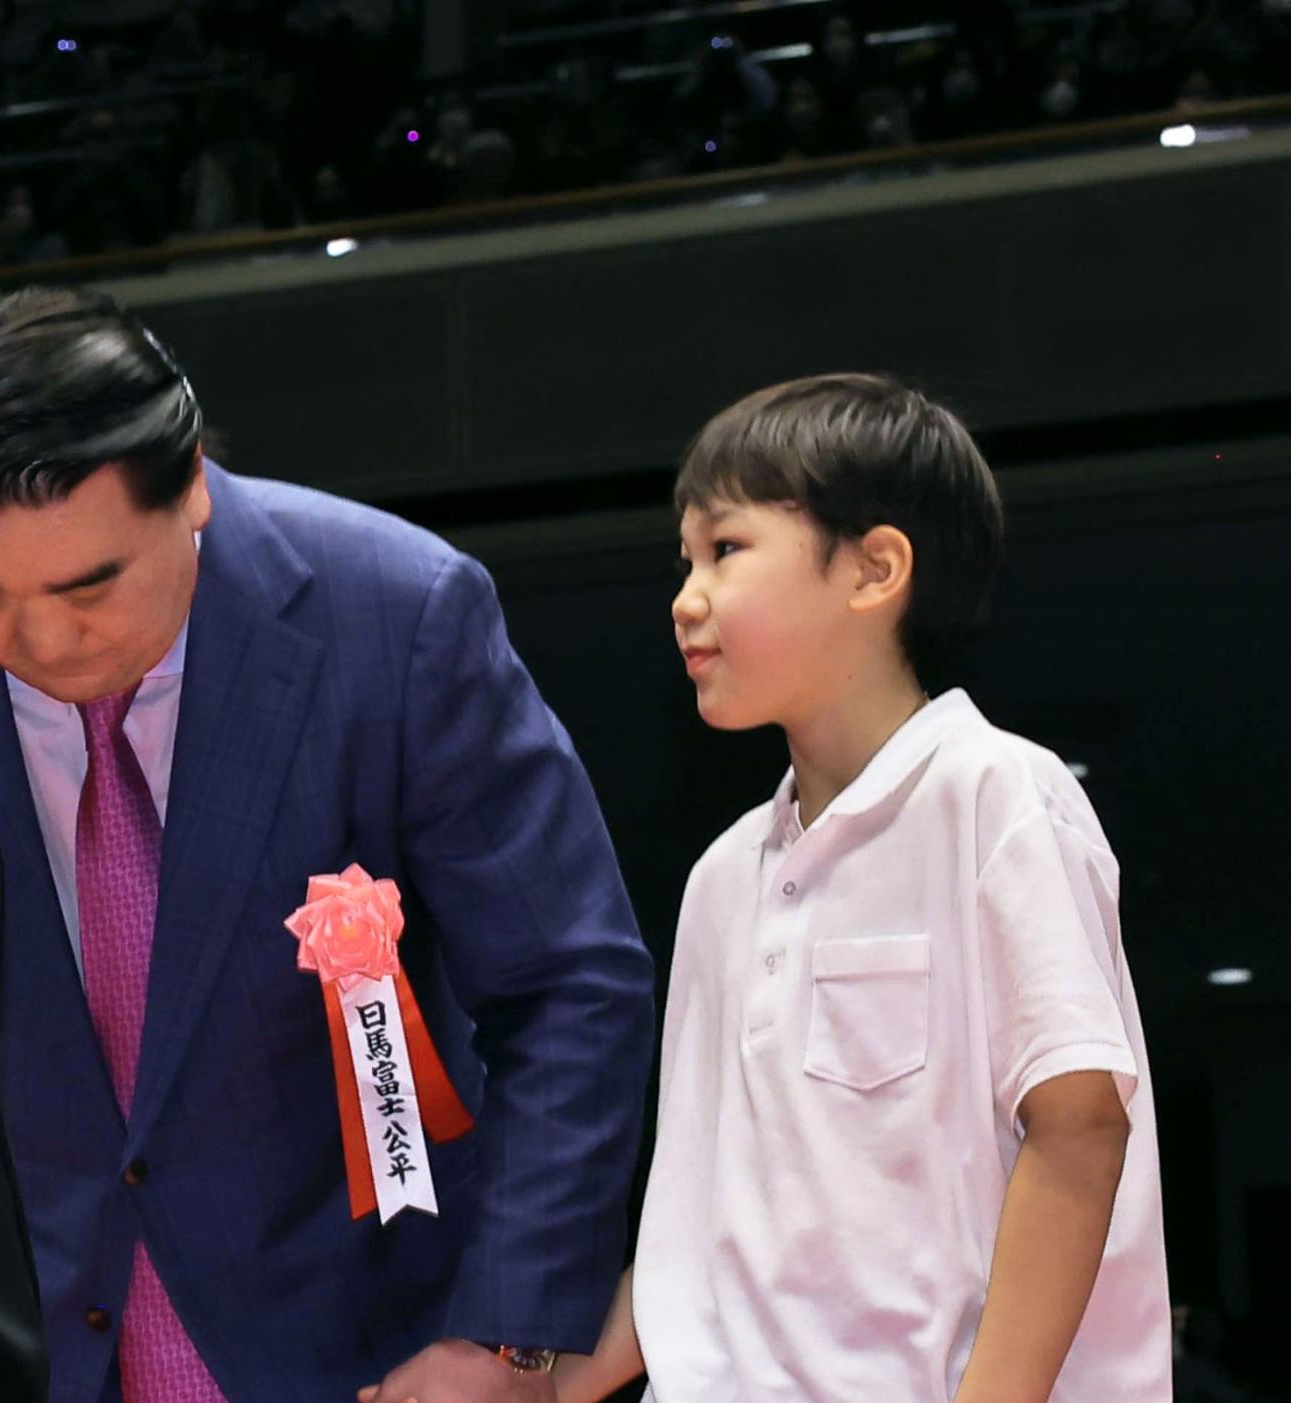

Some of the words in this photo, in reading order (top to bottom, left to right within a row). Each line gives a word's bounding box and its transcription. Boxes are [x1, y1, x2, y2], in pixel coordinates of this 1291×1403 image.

[355, 999, 417, 1187] 日馬富士公平
